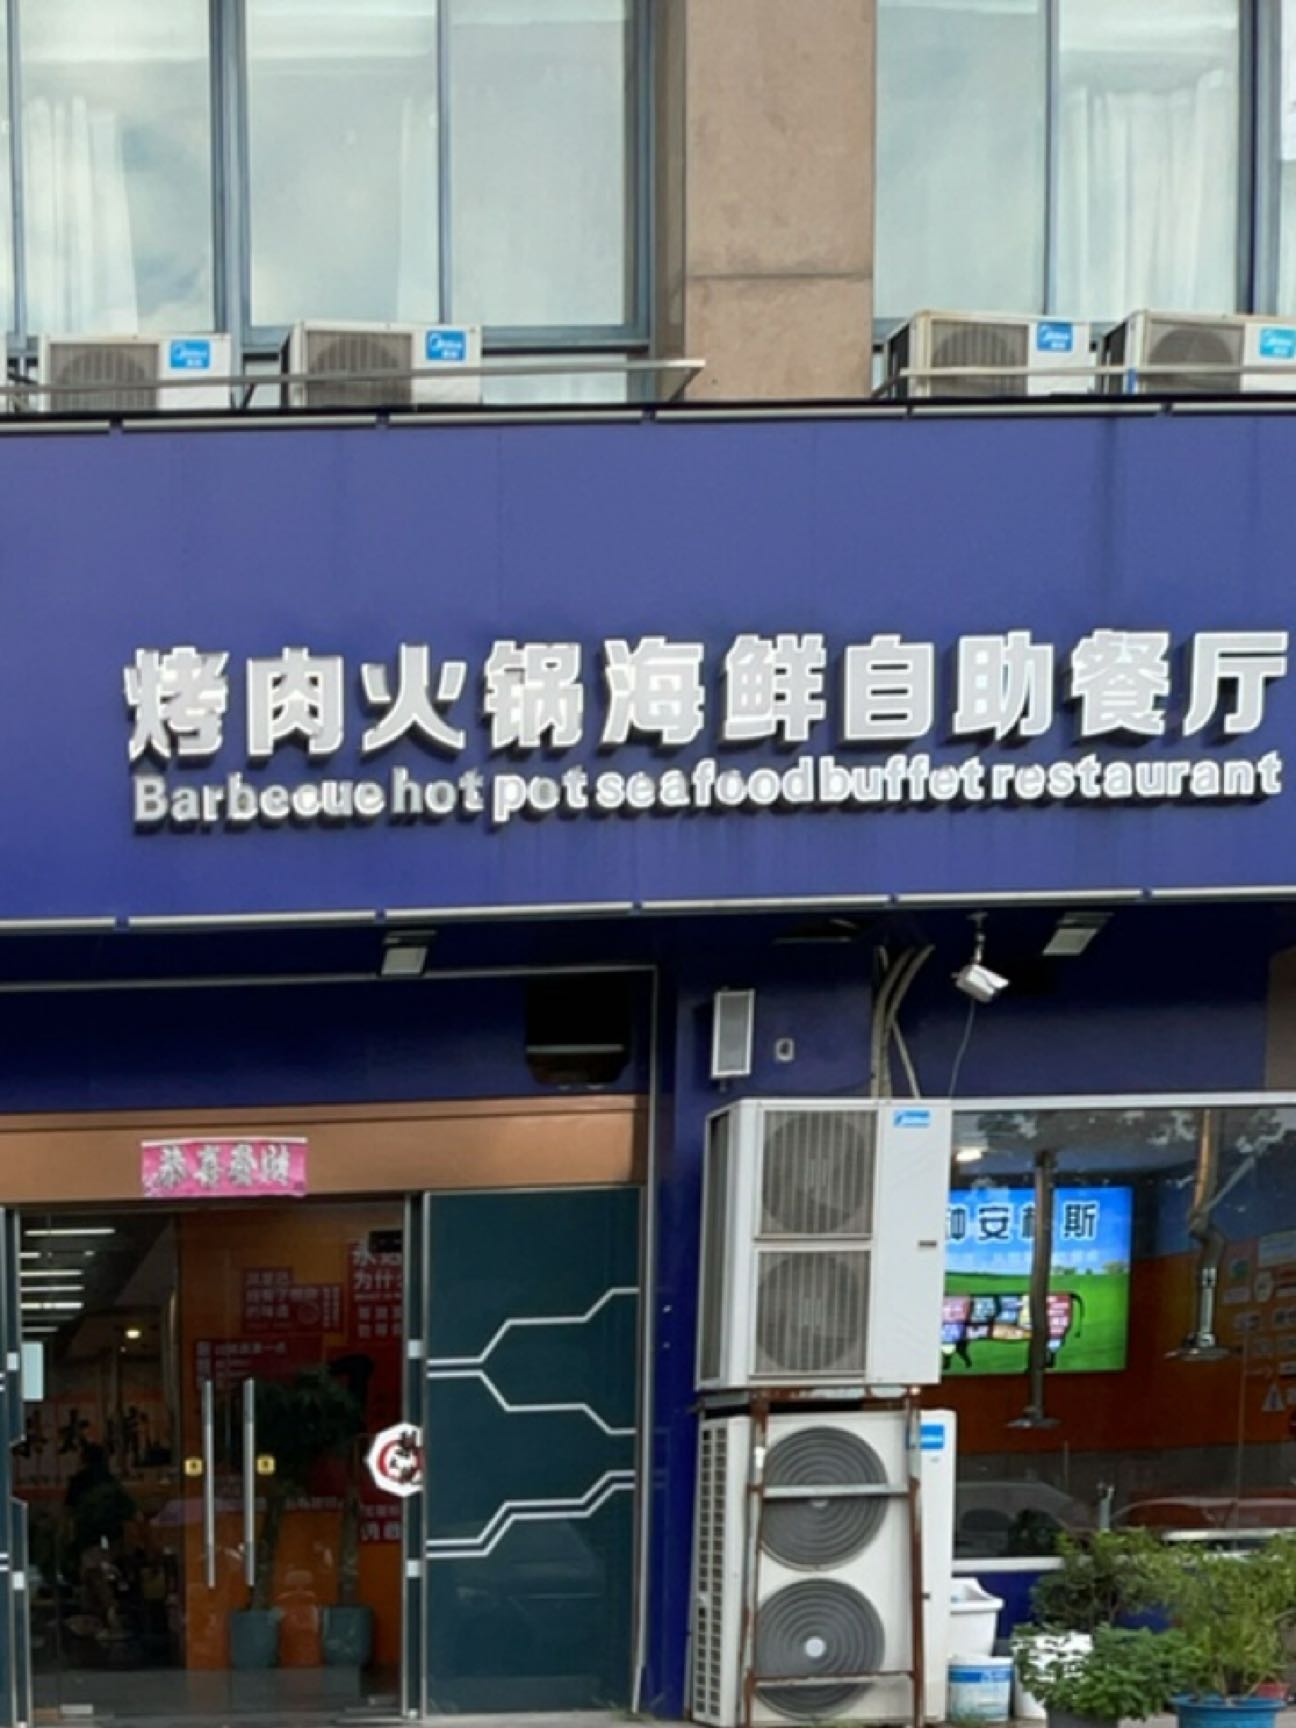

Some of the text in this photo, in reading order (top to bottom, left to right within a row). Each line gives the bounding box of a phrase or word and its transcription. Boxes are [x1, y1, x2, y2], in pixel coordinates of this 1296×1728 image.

[124, 629, 1290, 762] 烤肉火锅海鲜自助餐厅
[132, 751, 1283, 824] Barbecue hot pot seafood buffet restaurant
